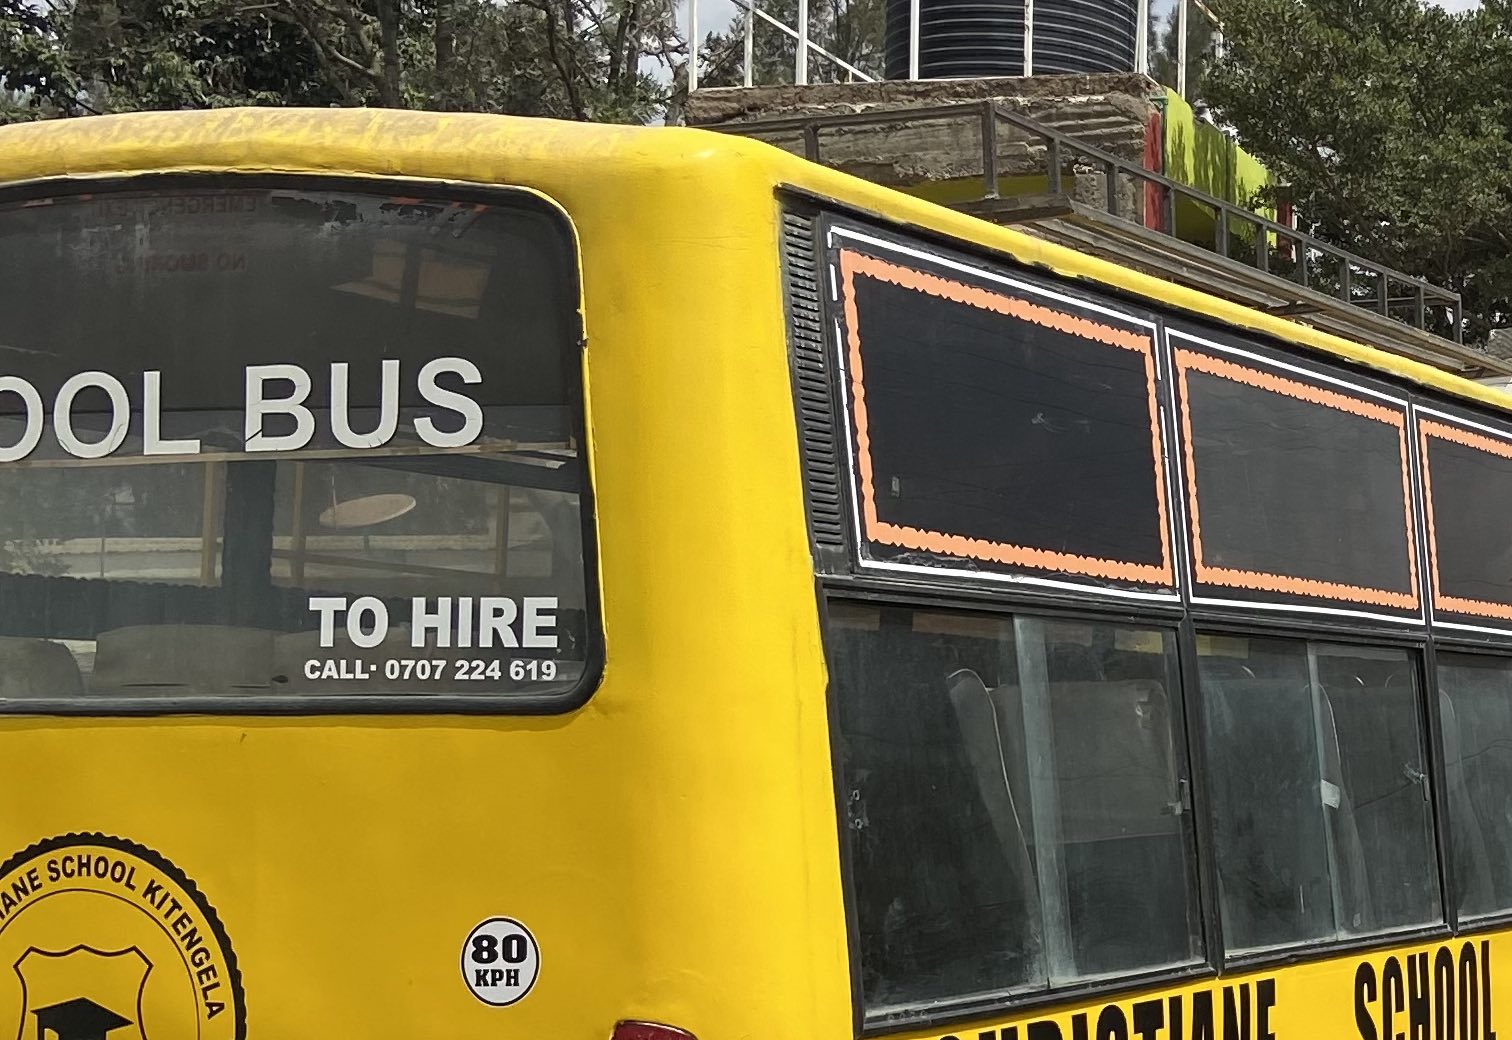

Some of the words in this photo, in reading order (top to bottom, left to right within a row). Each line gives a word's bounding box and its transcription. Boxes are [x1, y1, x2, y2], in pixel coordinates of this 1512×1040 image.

[245, 357, 484, 453] BUS
[308, 597, 389, 649] TO
[411, 597, 559, 649] HIRE
[385, 659, 447, 680] 0707
[454, 659, 501, 680] 224
[509, 660, 557, 681] 619
[47, 854, 136, 892] SCHOOL
[142, 878, 225, 1020] KITENGELA
[471, 933, 528, 964] 80
[475, 968, 520, 987] KPH
